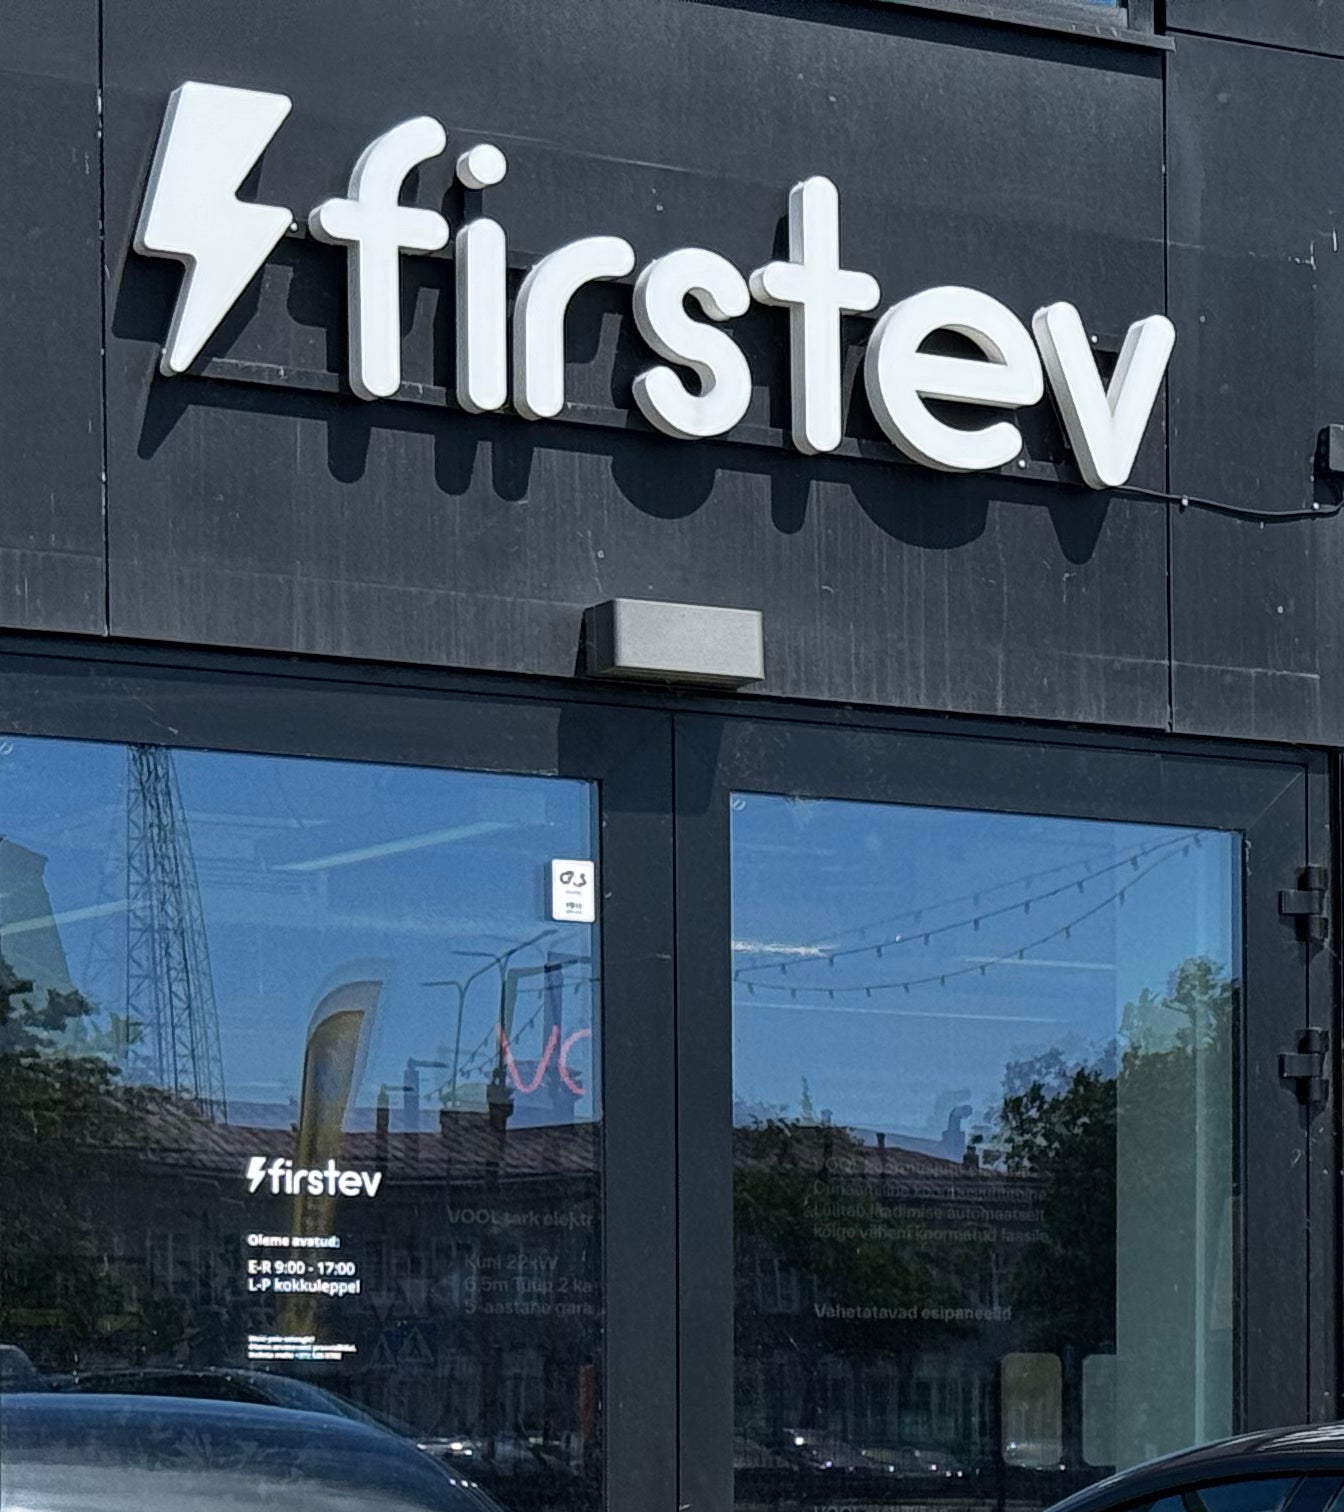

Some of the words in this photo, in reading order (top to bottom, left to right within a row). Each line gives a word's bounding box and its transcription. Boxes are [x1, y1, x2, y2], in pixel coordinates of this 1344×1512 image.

[309, 115, 1176, 490] firstev
[268, 1158, 382, 1197] firstev
[247, 1260, 272, 1275] E-R
[274, 1261, 306, 1275] 9:00
[317, 1261, 356, 1276] 17:00
[248, 1278, 272, 1292] L-P
[274, 1278, 361, 1297] kokkuleppel
